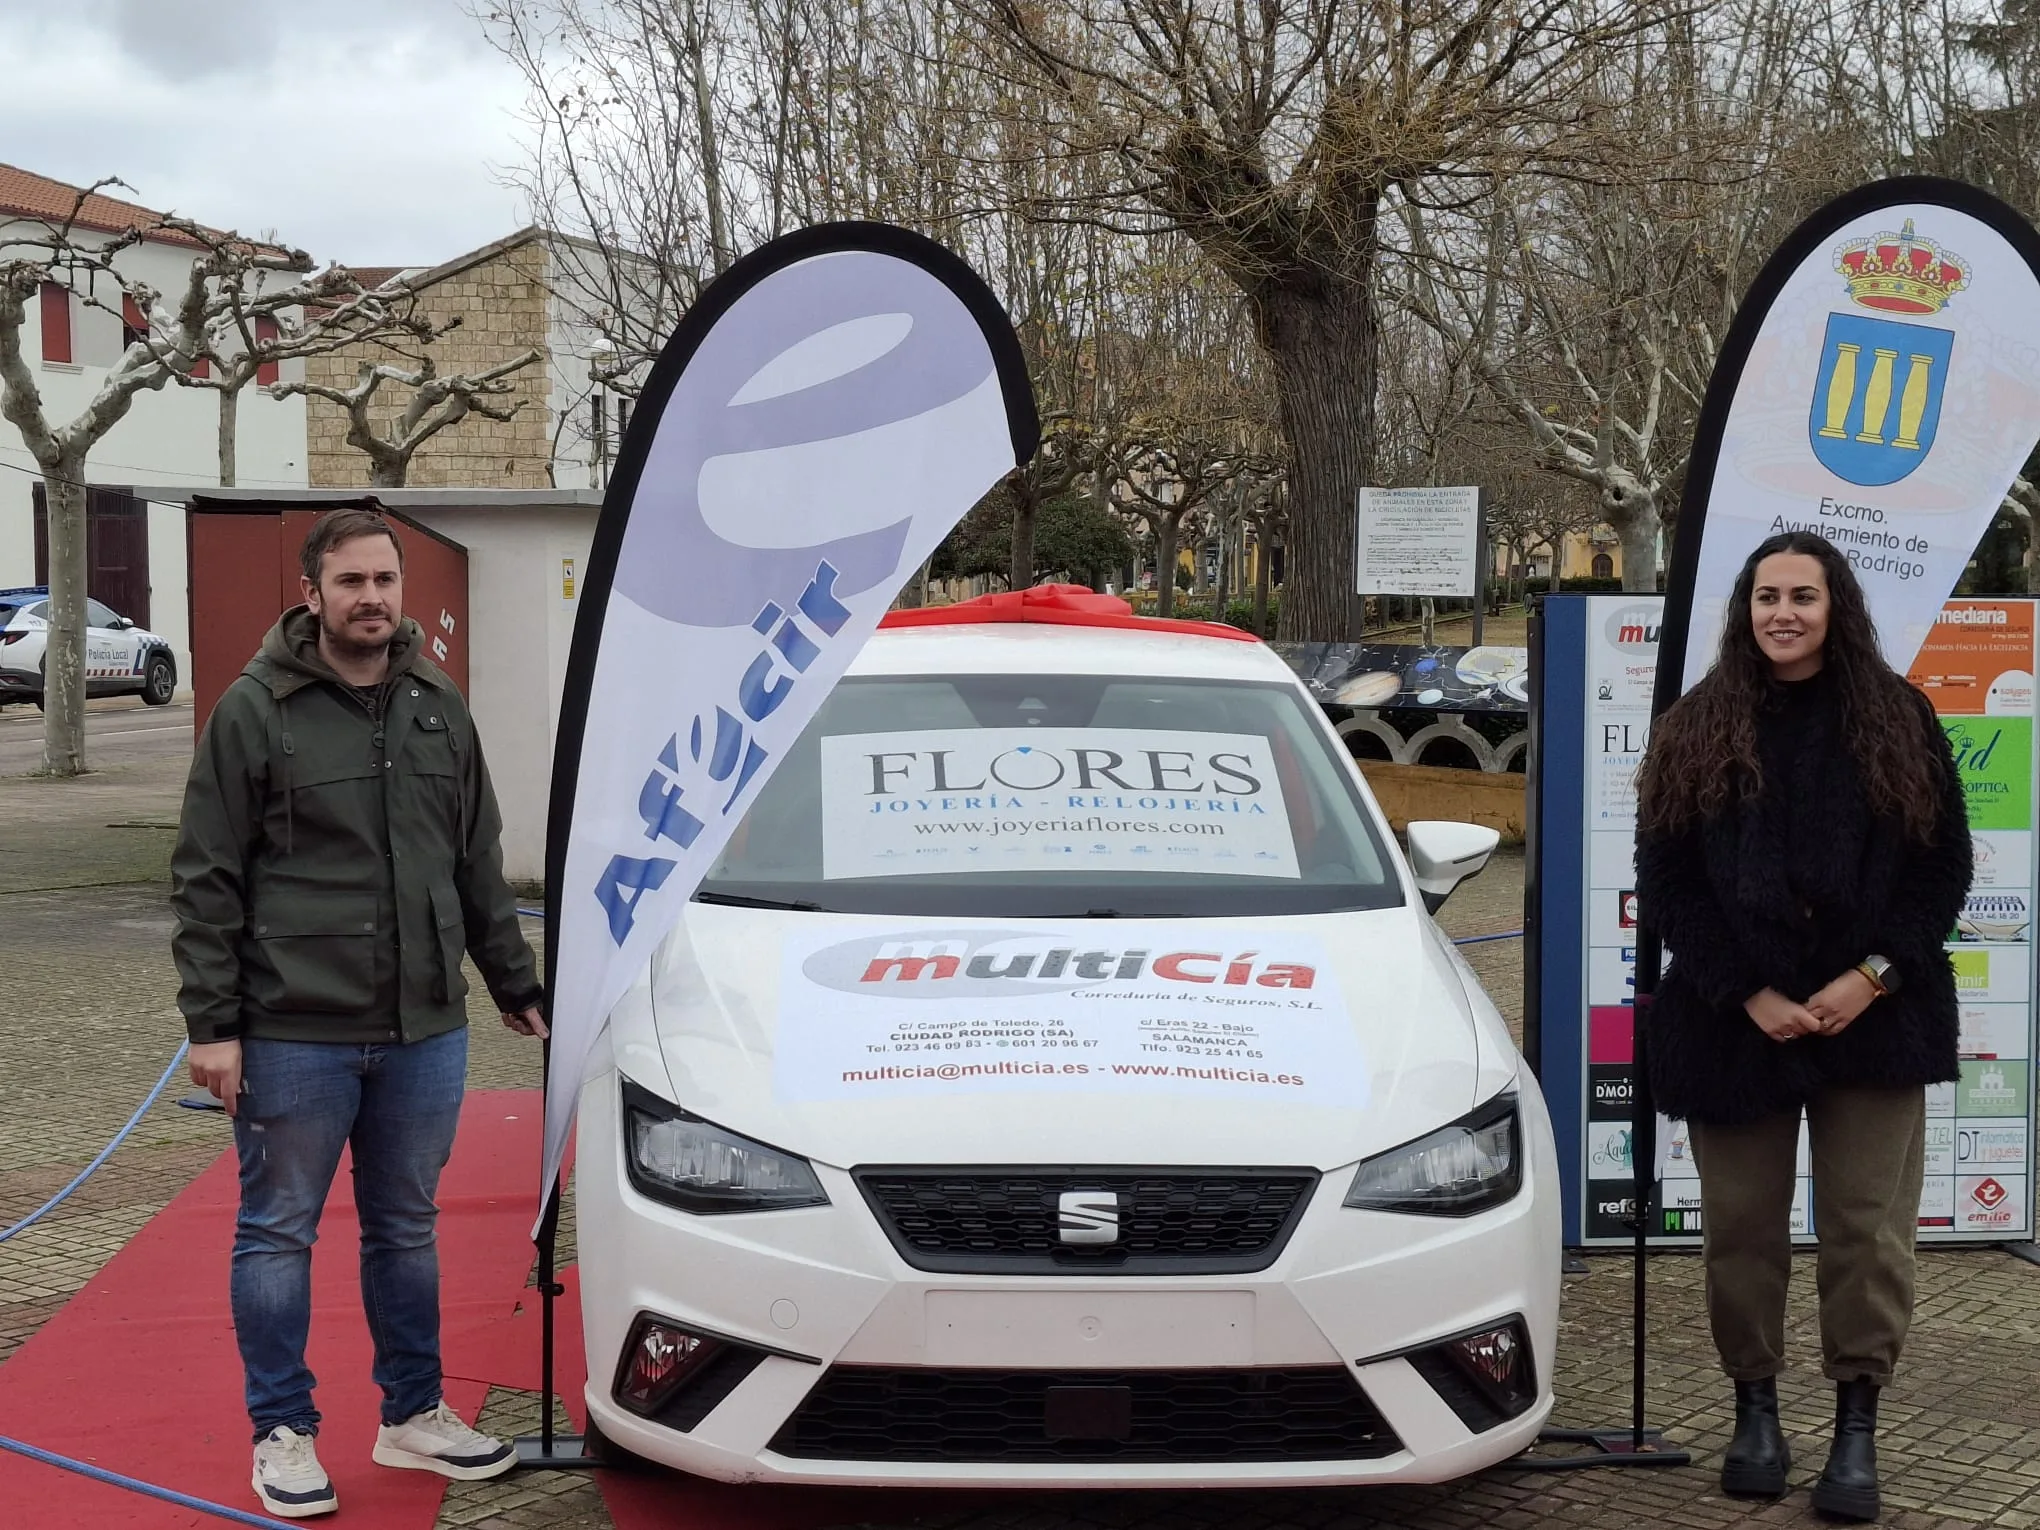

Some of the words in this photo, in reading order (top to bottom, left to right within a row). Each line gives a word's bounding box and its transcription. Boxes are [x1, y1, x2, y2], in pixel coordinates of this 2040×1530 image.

[1818, 496, 1888, 524] Excmo.
[1905, 535, 1929, 554] de
[1847, 549, 1925, 580] Rodrigo
[1625, 666, 1656, 677] Seguro
[864, 745, 1263, 797] FLORES
[869, 794, 1025, 815] JOYERÍA
[1067, 794, 1266, 815] RELOJERÍA
[914, 816, 1226, 836] www.joyeriaflores.com
[1178, 992, 1198, 1002] de
[1203, 995, 1282, 1008] Seguros,
[898, 1022, 914, 1031] C/
[917, 1020, 967, 1031] Campo
[971, 1019, 988, 1027] de
[992, 1019, 1044, 1029] Toledo,
[1048, 1019, 1065, 1028] 26
[1157, 1018, 1188, 1027] Eras
[1192, 1021, 1209, 1030] 22
[1221, 1023, 1254, 1033] Bajo
[889, 1031, 954, 1041] CIUDAD
[958, 1029, 1036, 1038] RODRIGO
[1040, 1029, 1074, 1039] (SA)
[1152, 1033, 1248, 1047] SALAMANCA
[865, 1044, 890, 1053] Tel.
[894, 1043, 920, 1052] 923
[923, 1042, 941, 1051] 46
[944, 1041, 961, 1050] 09
[965, 1039, 982, 1048] 83
[1012, 1039, 1036, 1048] 601
[1041, 1039, 1058, 1048] 20
[1062, 1039, 1079, 1048] 96
[1083, 1039, 1099, 1048] 67
[1175, 1044, 1201, 1055] 923
[1205, 1047, 1222, 1056] 25
[1225, 1049, 1241, 1057] 41
[1246, 1050, 1264, 1059] 65
[841, 1060, 1090, 1082] multicia@multicia.es
[1111, 1063, 1305, 1086] www.multicia.es
[1958, 1130, 1980, 1161] DT
[1968, 1211, 2011, 1222] emilio
